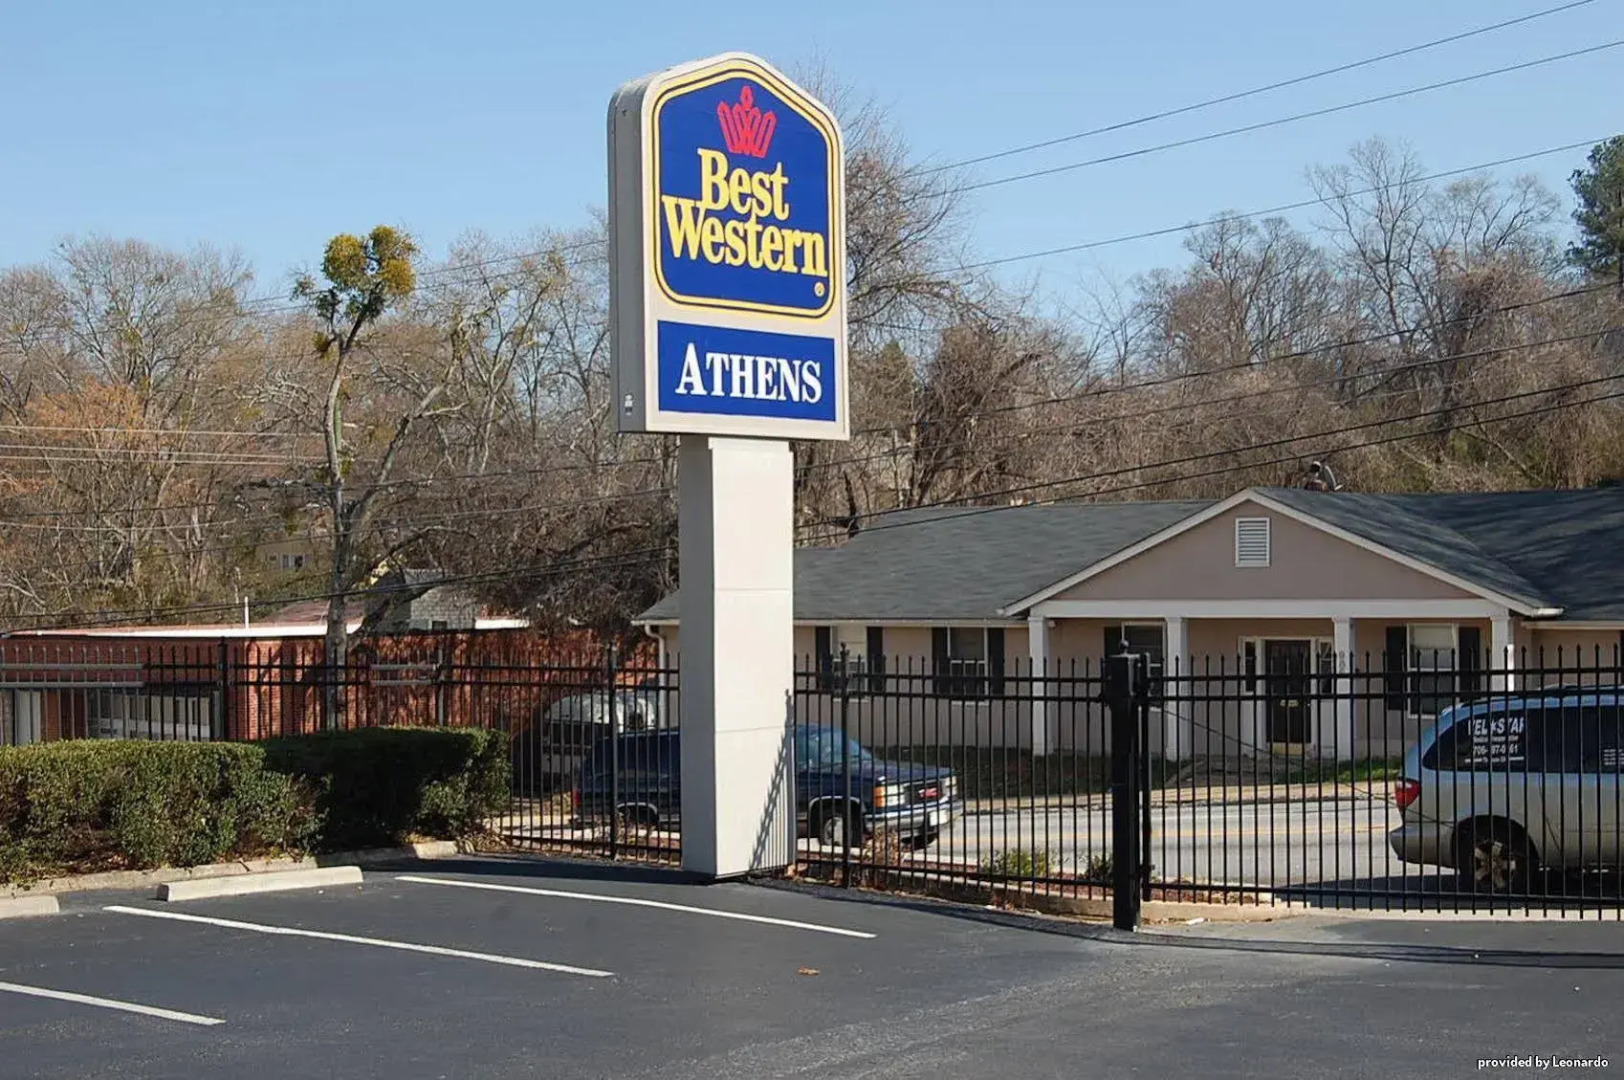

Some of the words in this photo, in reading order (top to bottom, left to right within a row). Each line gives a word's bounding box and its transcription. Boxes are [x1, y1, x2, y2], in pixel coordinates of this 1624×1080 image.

[697, 147, 789, 221] Best
[661, 195, 828, 277] Western
[675, 342, 822, 404] ATHENS
